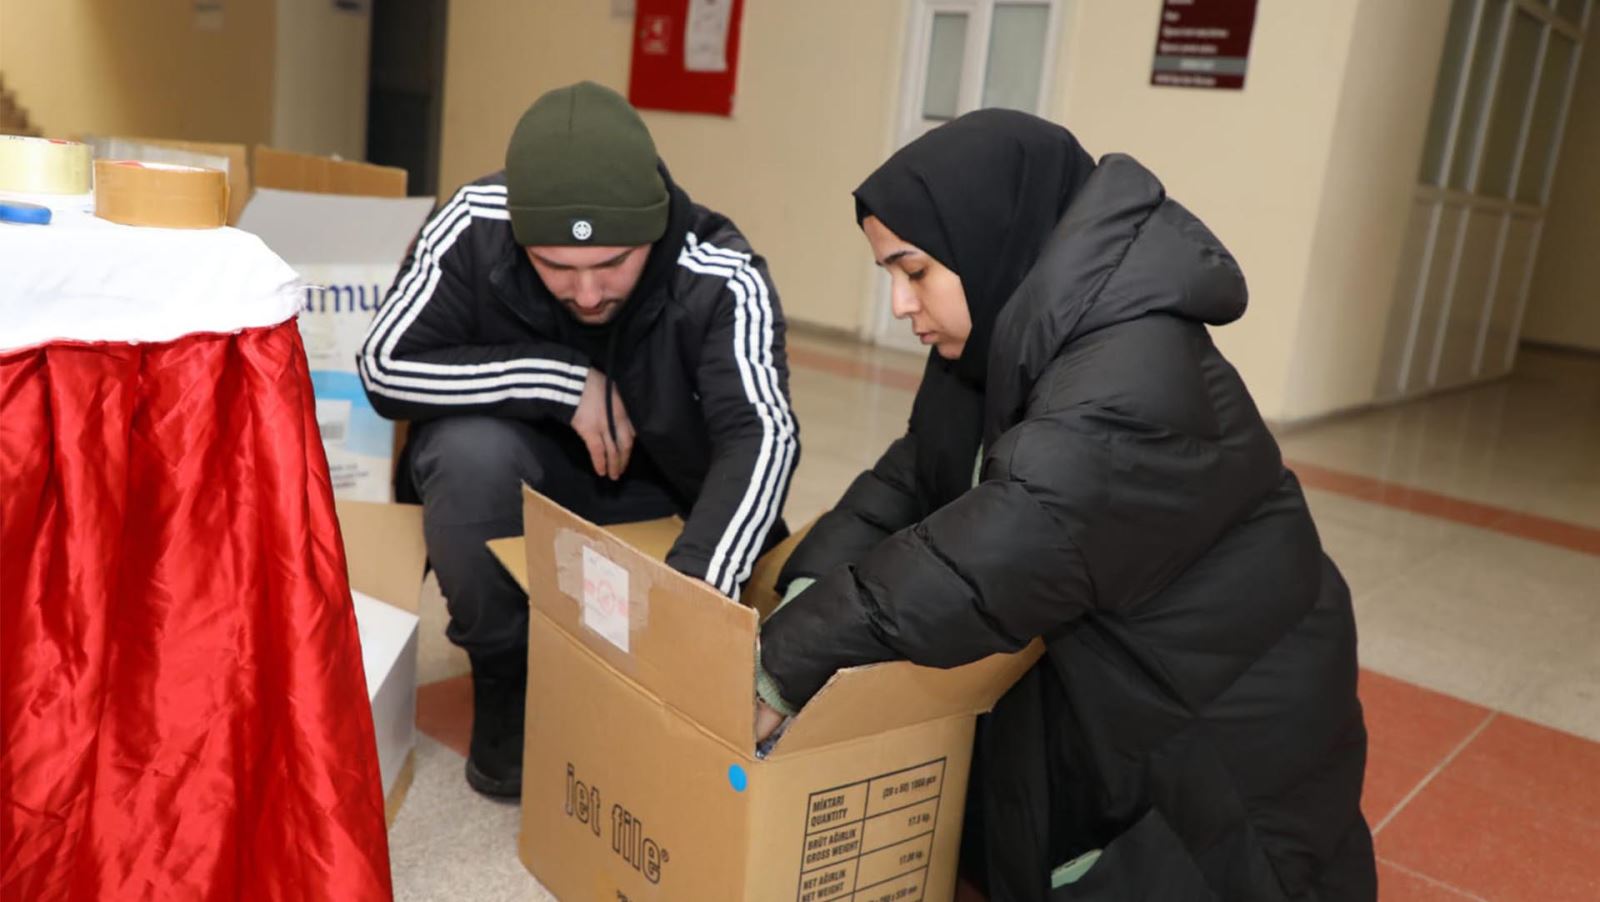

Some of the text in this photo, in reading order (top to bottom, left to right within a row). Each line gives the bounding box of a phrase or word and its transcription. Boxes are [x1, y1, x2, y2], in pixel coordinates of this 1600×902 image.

[565, 761, 600, 837] jet
[811, 808, 848, 827] QUANTITY
[806, 840, 859, 864] GROSS WEIGHT
[807, 835, 828, 851] BRÜT
[803, 878, 817, 890] NET
